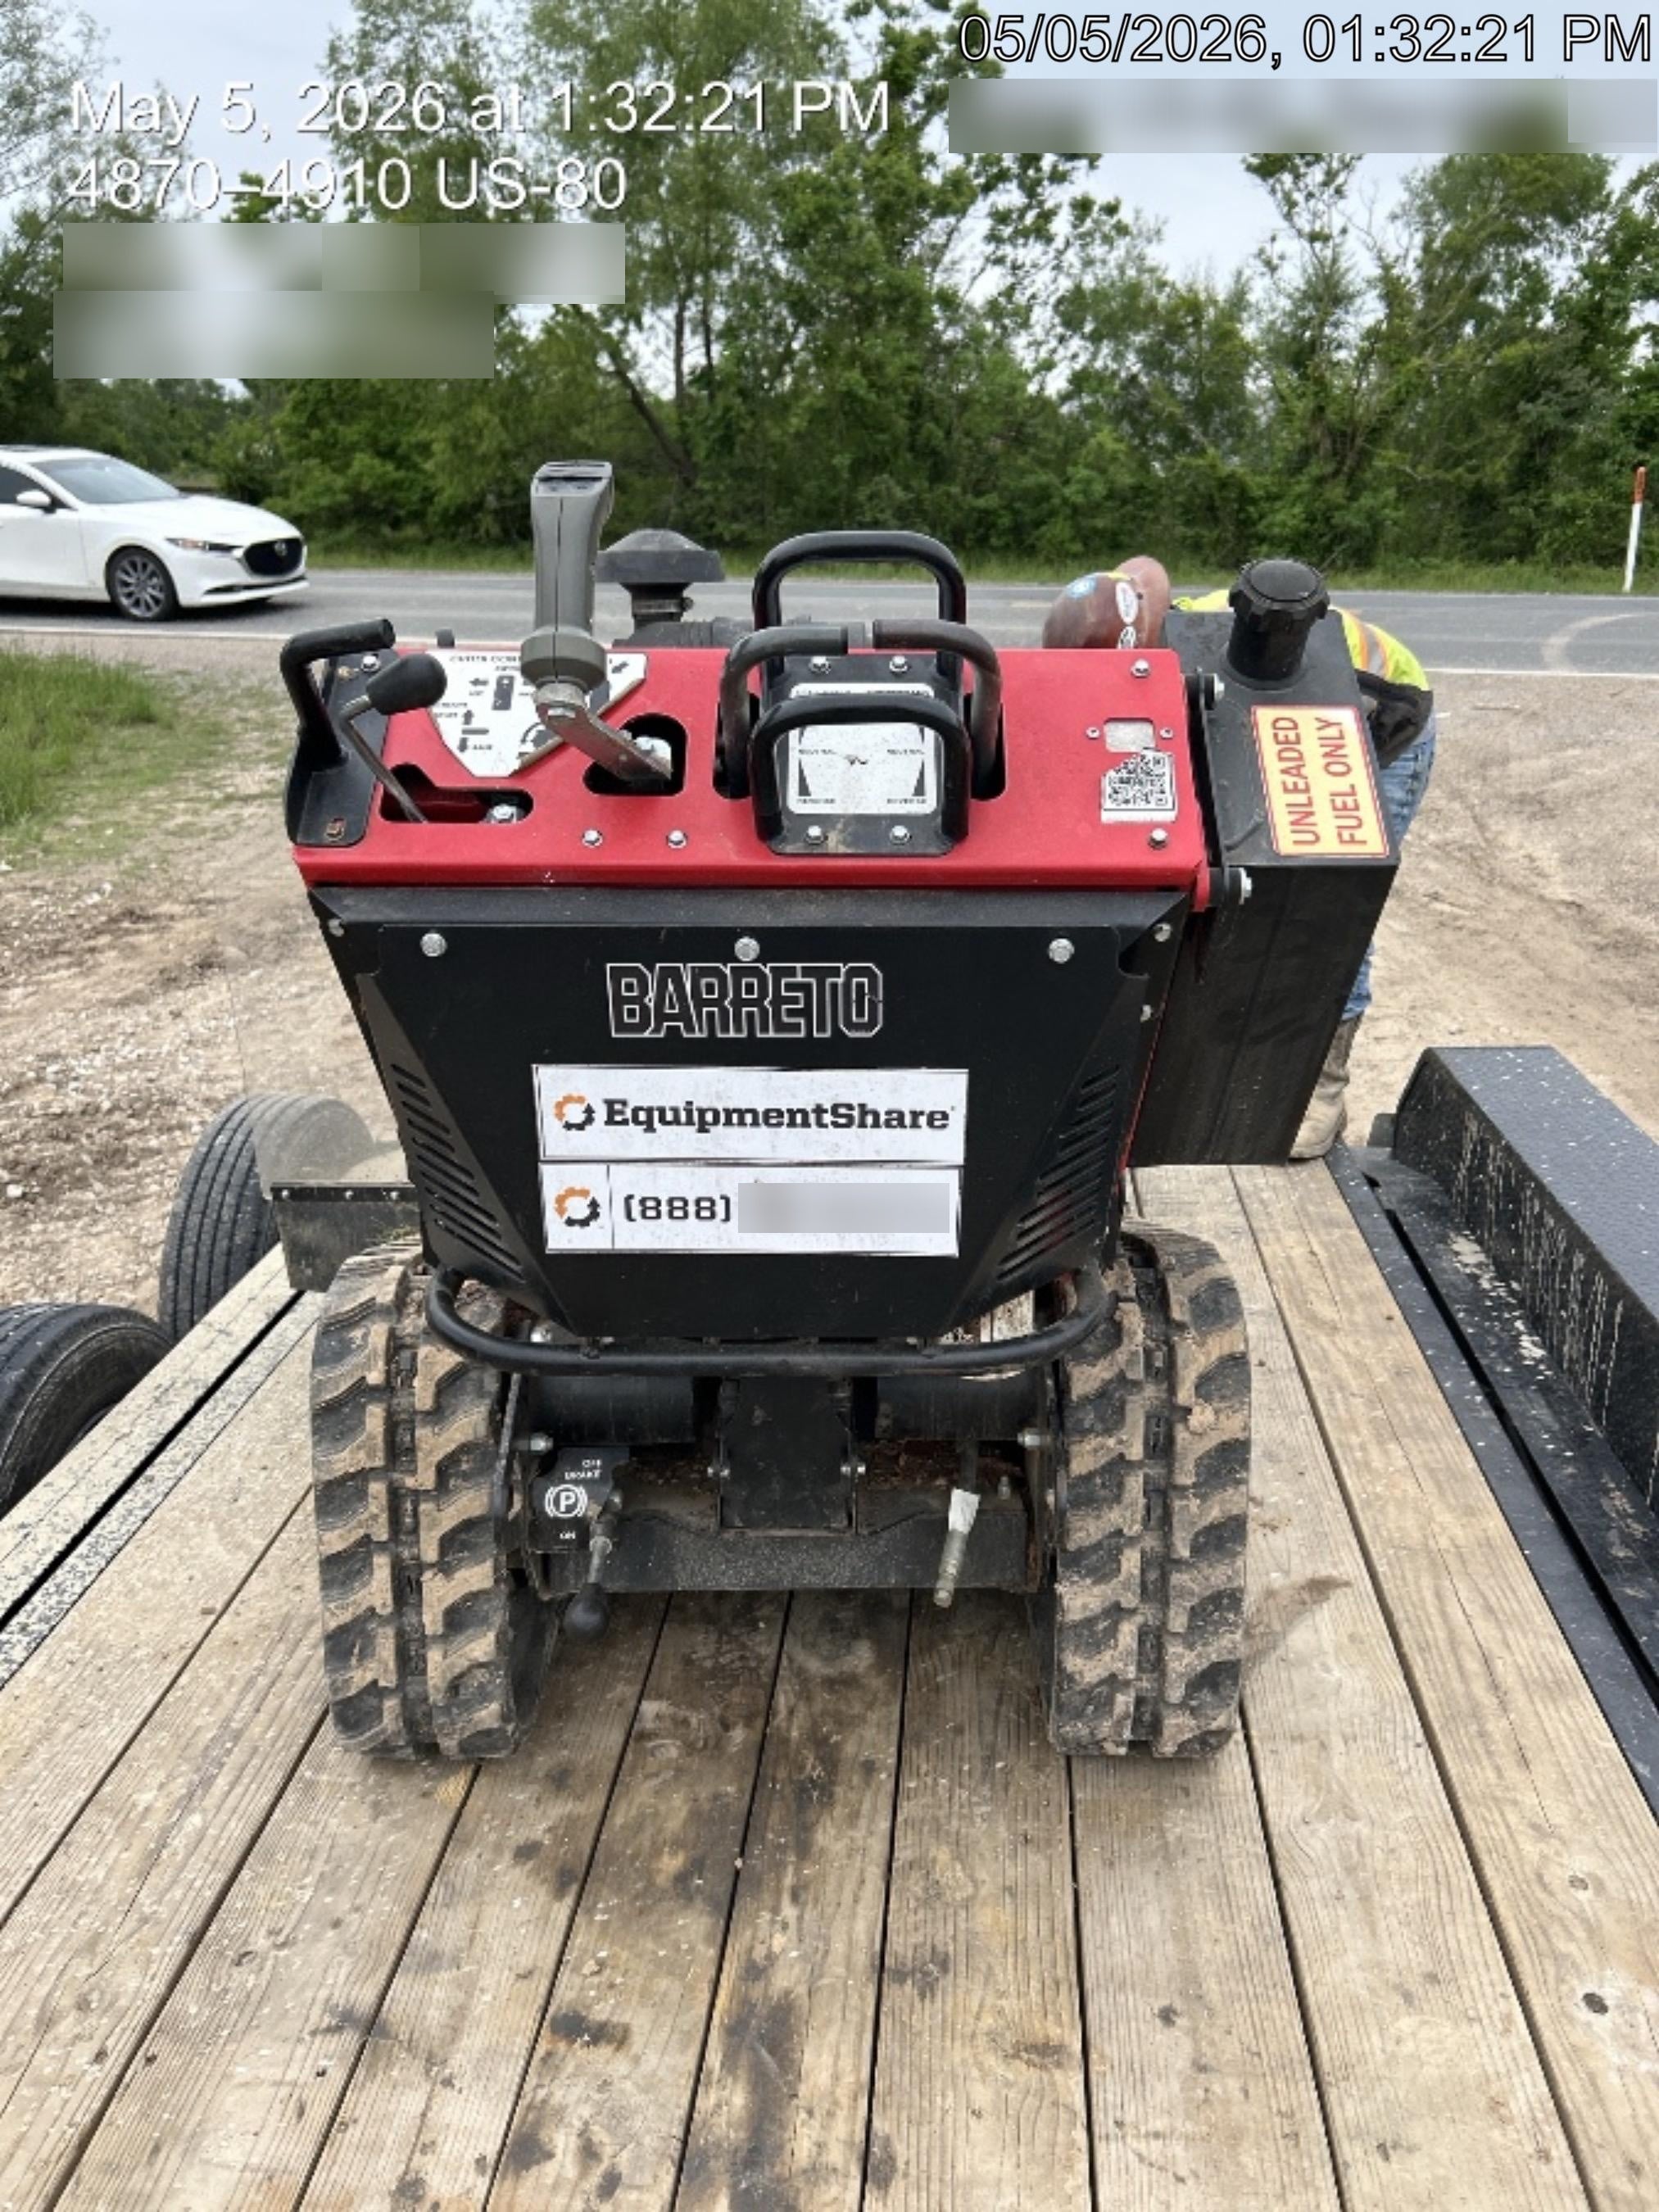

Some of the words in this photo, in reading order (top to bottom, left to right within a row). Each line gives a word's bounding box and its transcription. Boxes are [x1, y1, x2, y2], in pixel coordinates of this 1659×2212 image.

[1314, 717, 1353, 777] ONLY
[1271, 717, 1321, 846] UNLEADED
[1329, 783, 1367, 846] FUEL
[605, 962, 884, 1039] BARRETO
[603, 1099, 950, 1133] EquipmentShare
[623, 1194, 732, 1222] (888)
